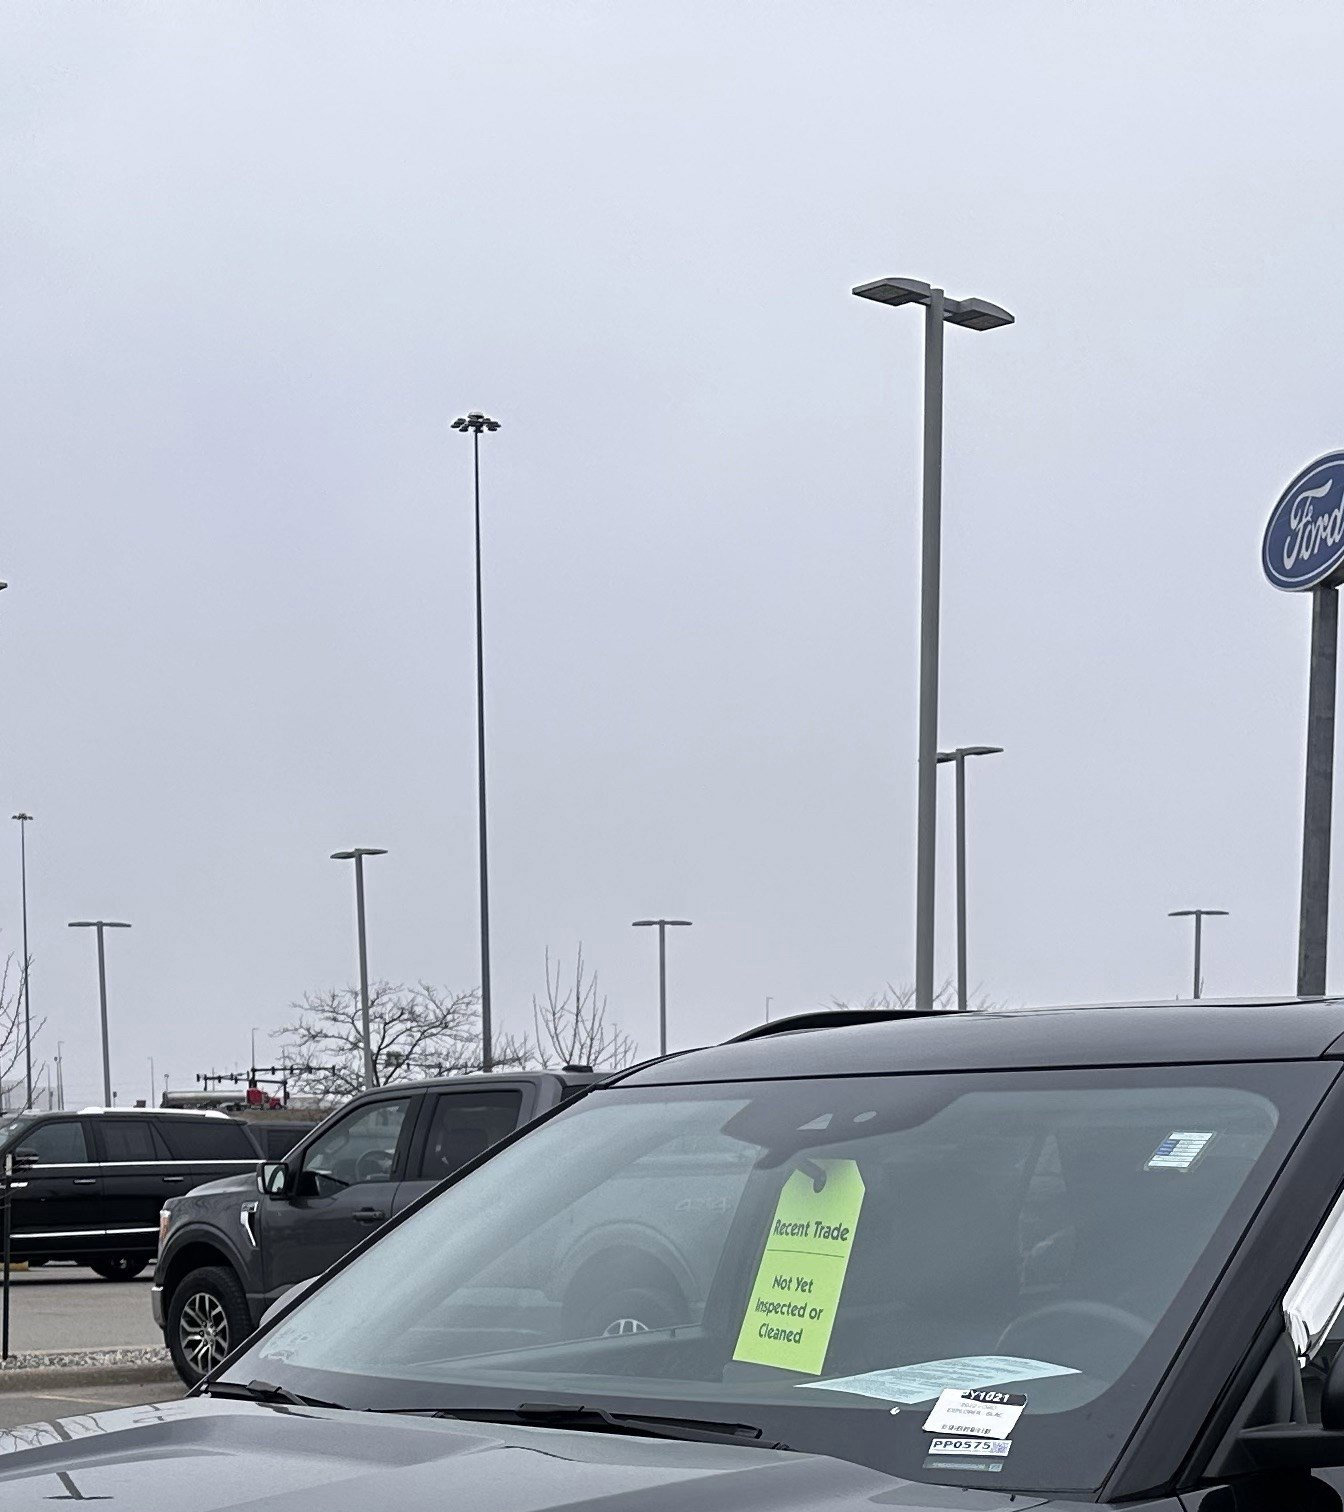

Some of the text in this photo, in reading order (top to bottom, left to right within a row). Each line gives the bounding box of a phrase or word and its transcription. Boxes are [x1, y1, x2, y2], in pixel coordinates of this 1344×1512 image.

[773, 1219, 850, 1241] Recent Trade
[772, 1275, 813, 1294] Not Yet
[755, 1297, 824, 1320] Inspected or
[758, 1323, 803, 1344] Cleaned
